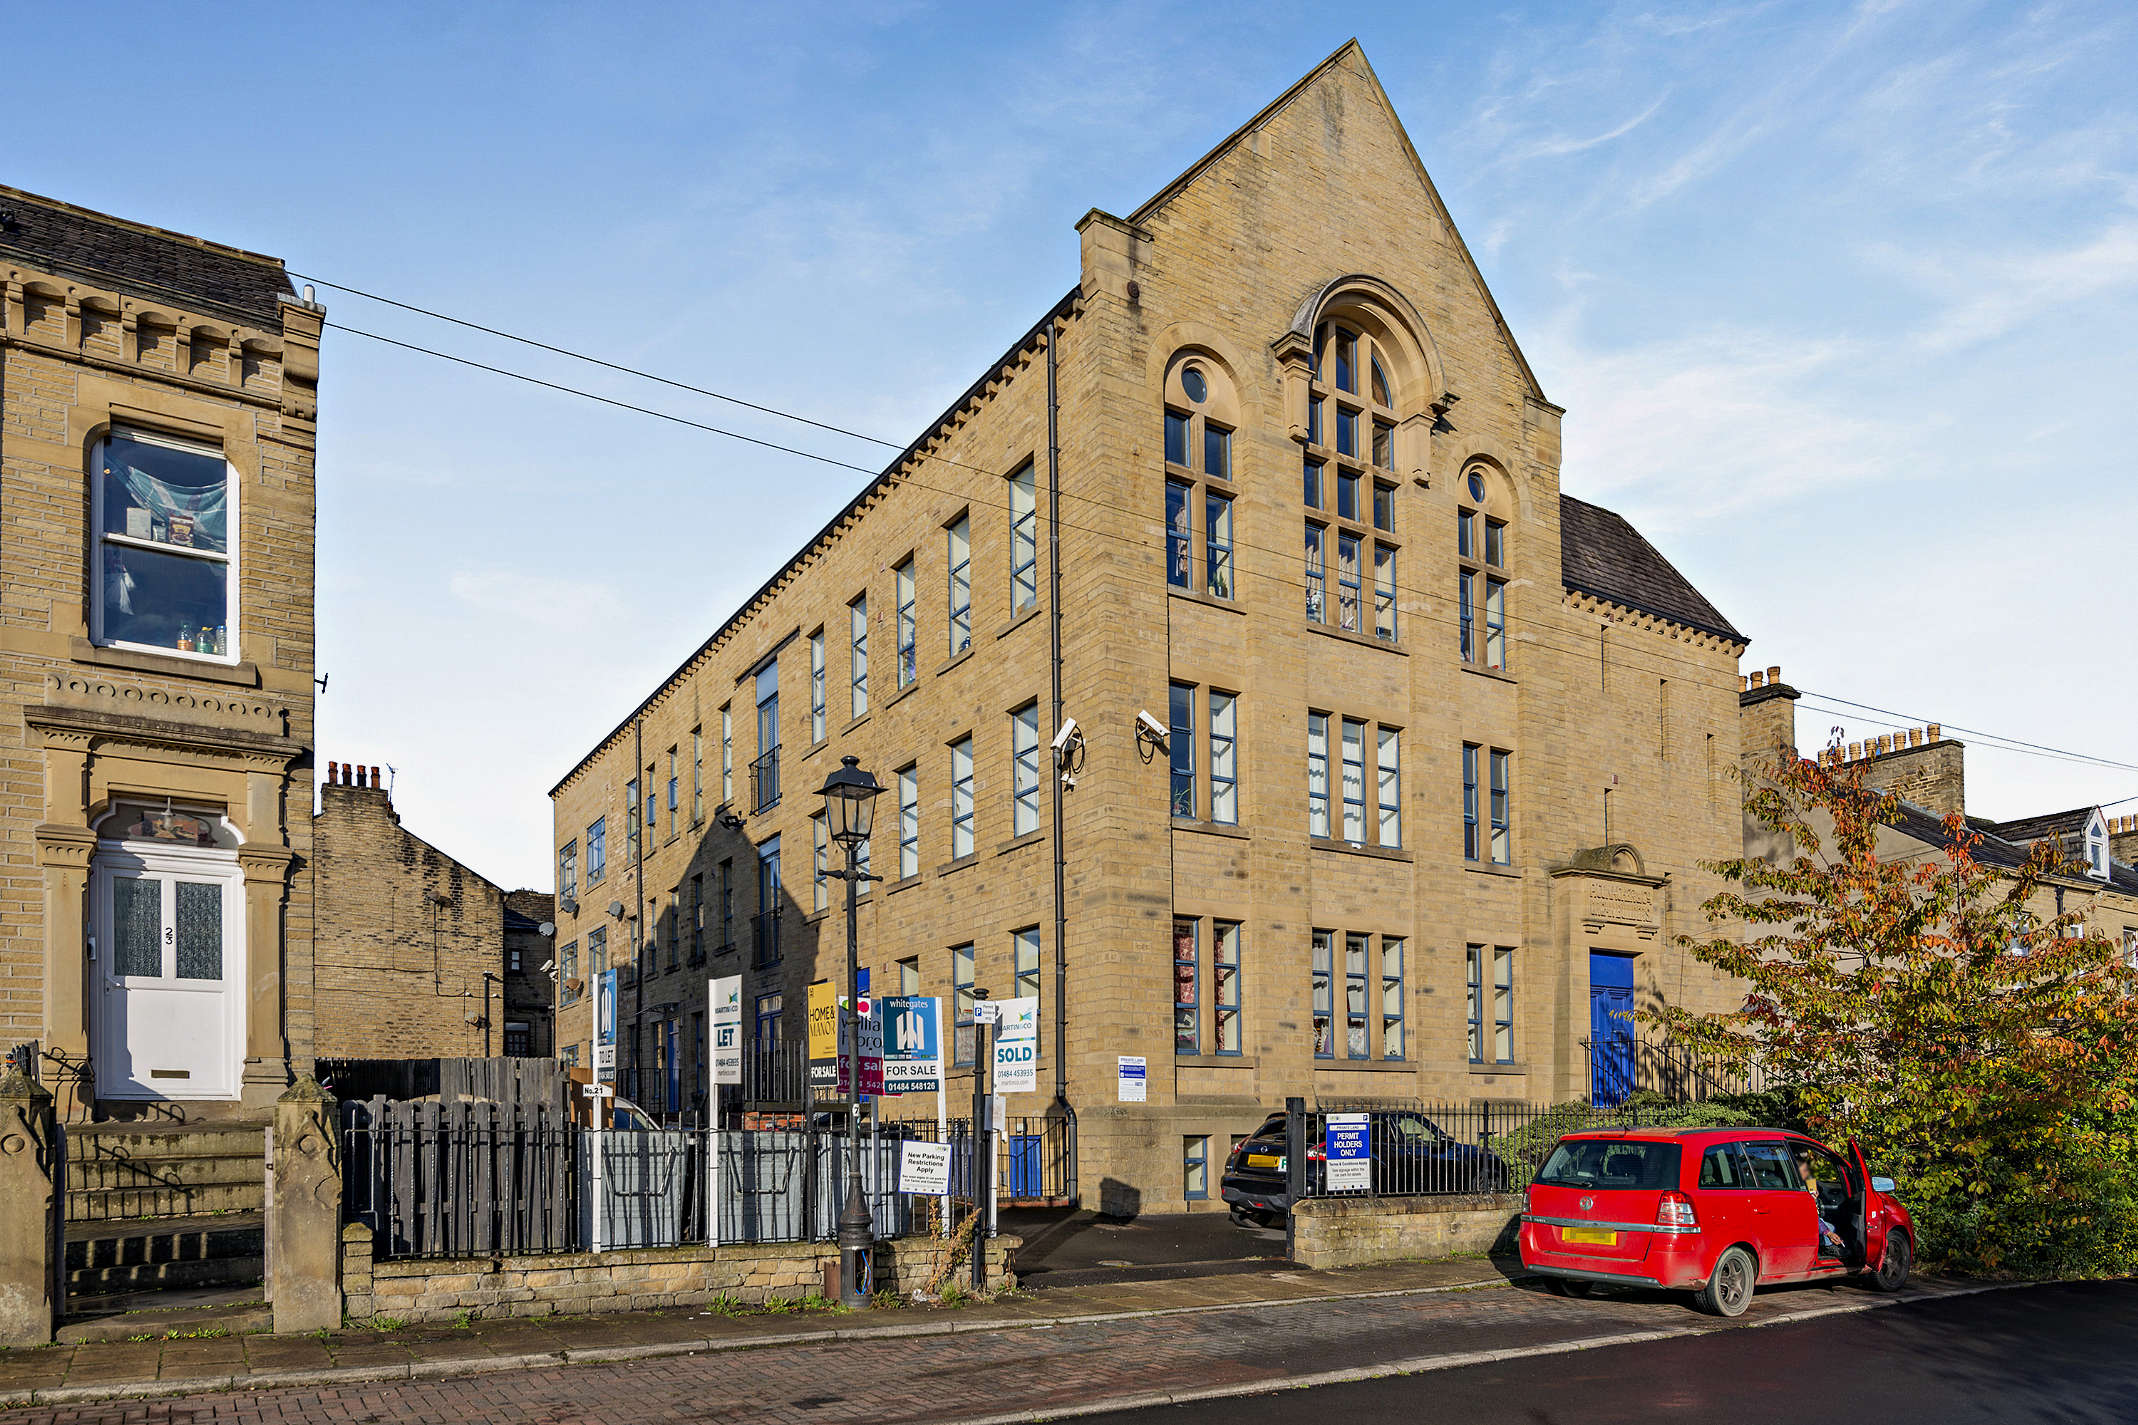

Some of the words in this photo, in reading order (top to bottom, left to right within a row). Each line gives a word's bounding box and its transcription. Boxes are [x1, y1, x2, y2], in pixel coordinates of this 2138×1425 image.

[890, 999, 929, 1010] whitegates
[717, 1028, 734, 1047] LET
[997, 1047, 1032, 1063] SOLD
[864, 1060, 882, 1071] sal
[811, 1066, 823, 1078] FOR
[823, 1065, 837, 1078] SALE
[886, 1066, 908, 1076] FOR
[910, 1065, 936, 1075] SALE
[888, 1083, 909, 1091] 01484
[1337, 1132, 1360, 1140] PERMIT
[1333, 1140, 1363, 1149] HOLDERS
[922, 1153, 945, 1161] Parking
[1340, 1149, 1357, 1157] ONLY
[908, 1159, 944, 1167] Restrictions
[917, 1166, 934, 1174] Apply
